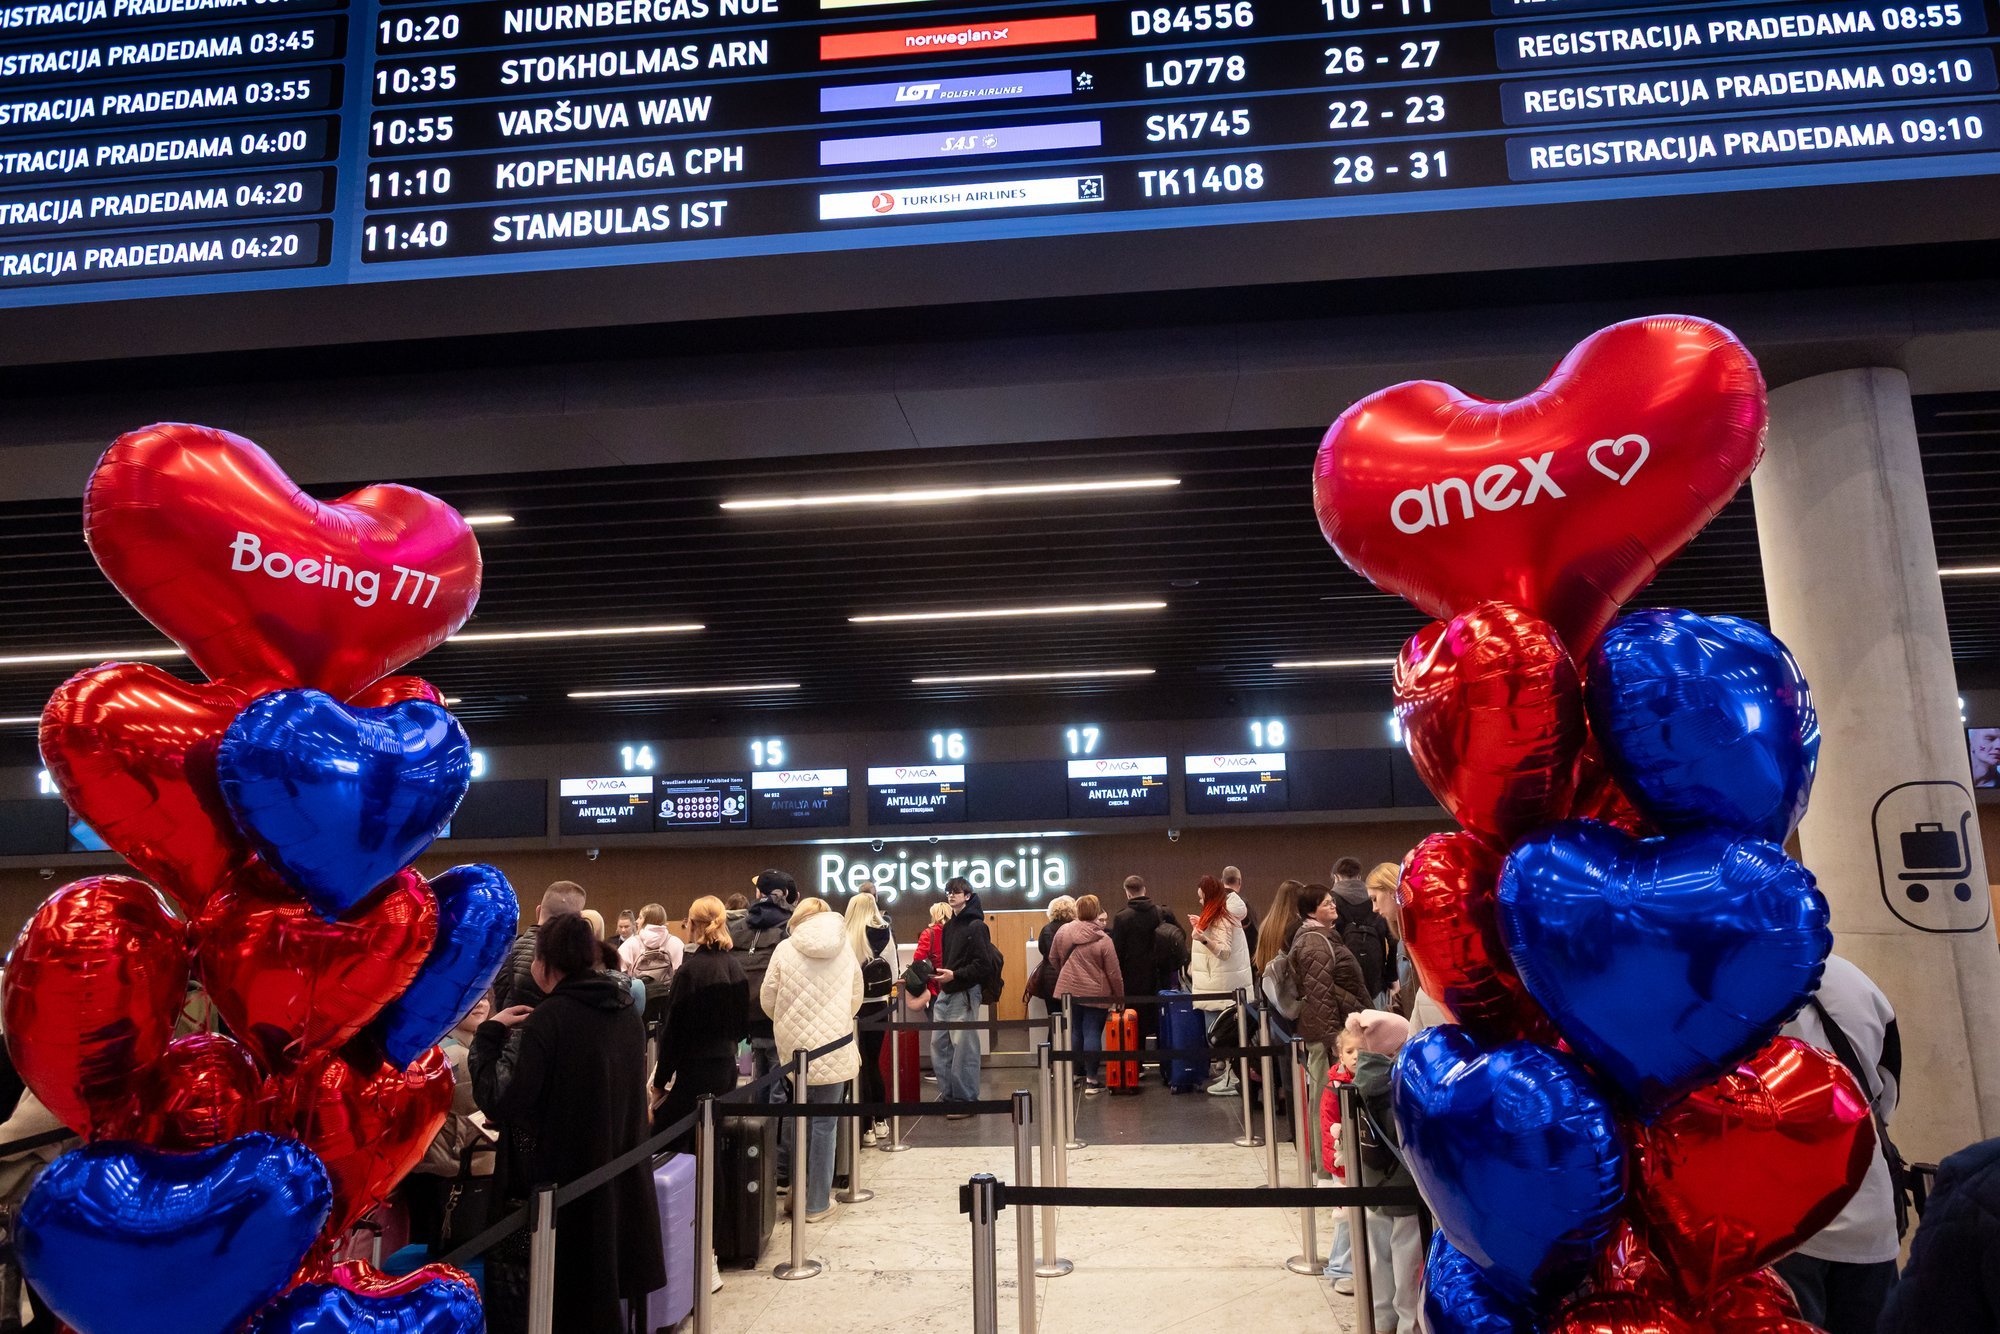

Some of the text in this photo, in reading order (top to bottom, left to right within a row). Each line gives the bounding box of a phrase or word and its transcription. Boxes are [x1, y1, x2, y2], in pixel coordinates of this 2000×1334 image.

[114, 0, 247, 17] PRADED
[505, 0, 709, 33] NIURNBERGAS
[1131, 2, 1253, 35] D84556
[1322, 0, 1359, 20] 10
[381, 15, 459, 43] 10:20
[906, 29, 991, 46] norwegian
[1519, 4, 1961, 58] REGISTRACIJA PRADEDAMA 08:55
[108, 37, 242, 66] PRADEDAMA
[250, 30, 314, 53] 03:45
[501, 40, 767, 84] STOKHOLMAS ARN
[1325, 47, 1364, 74] 26
[1401, 41, 1439, 68] 27
[377, 66, 455, 94] 10:35
[896, 84, 1023, 101] LOT POLISH AIRLINES
[1524, 59, 1972, 113] REGISTRACIJA PRADEDAMA 09:10
[0, 80, 310, 124] STRACIJA PRADEDAMA 03:55
[498, 96, 712, 136] VARŠUVA WAW
[1329, 101, 1369, 128] 22
[1406, 95, 1445, 123] 23
[373, 116, 453, 145] 10:55
[1146, 109, 1250, 141] SK745
[0, 130, 306, 173] TRACIJA PRADEDAMA 04:00
[941, 136, 978, 151] SAS
[1530, 116, 1982, 169] REGISTRACIJA PRADEDAMA 09:10
[497, 146, 742, 189] KOPENHAGA CPH
[1138, 163, 1264, 196] TK1408
[1333, 156, 1374, 184] 28
[1409, 151, 1447, 178] 31
[370, 168, 450, 198] 11:10
[902, 188, 1026, 206] TURKISH AIRLINES
[0, 182, 302, 224] TRACIJA PRADEDAMA 04:20
[366, 221, 447, 251] 11:40
[493, 201, 727, 242] STAMBULAS IST
[84, 240, 223, 269] PRADEDAMA
[231, 235, 298, 258] 04:20
[1391, 452, 1565, 533] anex
[230, 532, 440, 608] Boeing 777
[932, 733, 965, 759] 16
[1066, 727, 1099, 754] 17
[1250, 720, 1285, 747] 18
[621, 745, 654, 770] 14
[751, 740, 783, 766] 15
[1109, 762, 1138, 770] MGA
[1227, 758, 1256, 766] MGA
[38, 770, 60, 793] 1
[599, 780, 626, 789] MGA
[908, 769, 936, 777] MGA
[886, 795, 947, 806] ANTALIJA AYT
[1089, 788, 1148, 799] ANTALYA AYT
[1207, 784, 1266, 795] ANTALYA AYT
[579, 806, 634, 817] ANTALYA AYT
[821, 847, 1066, 904] Registracija
